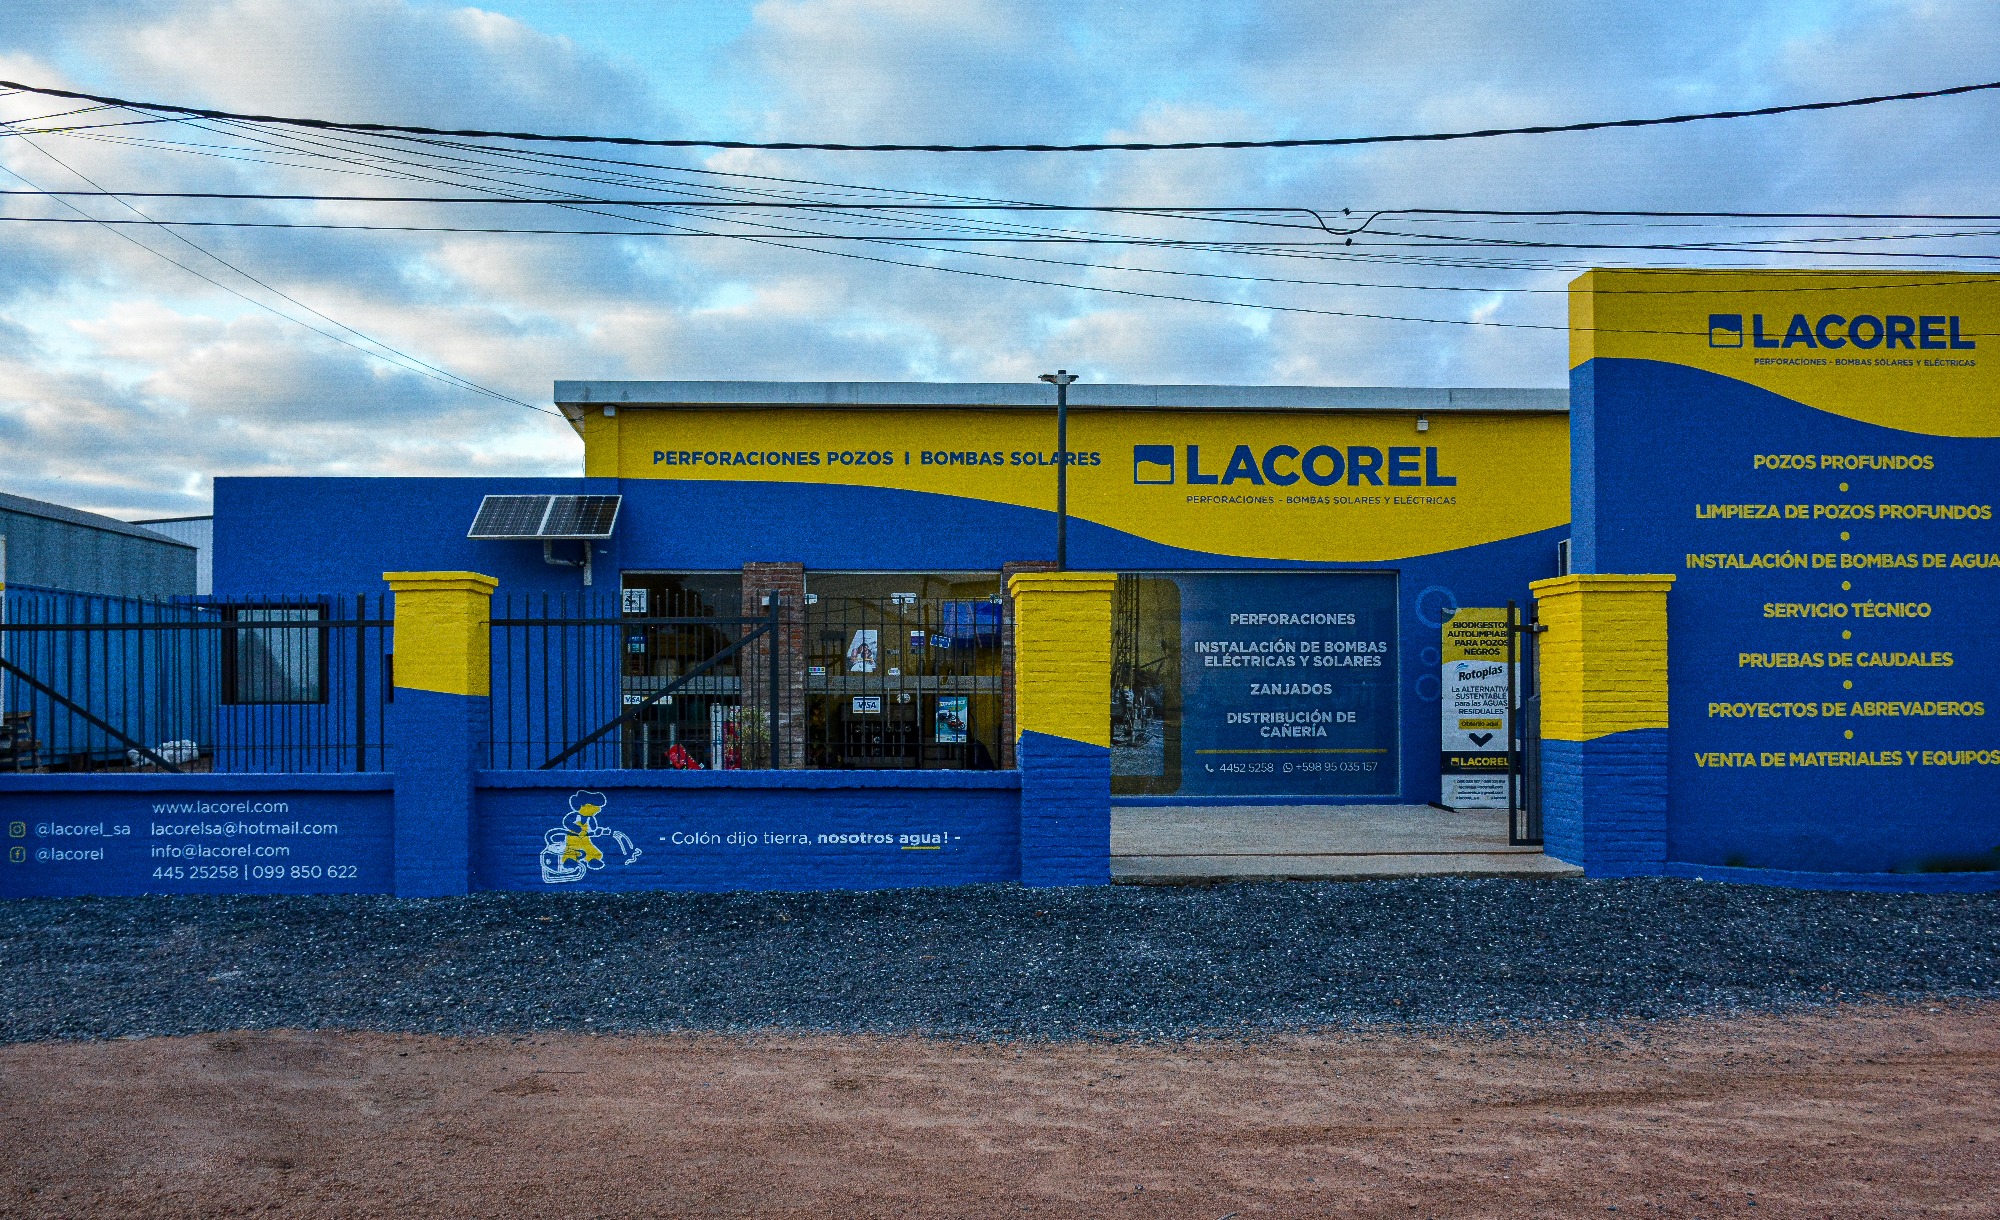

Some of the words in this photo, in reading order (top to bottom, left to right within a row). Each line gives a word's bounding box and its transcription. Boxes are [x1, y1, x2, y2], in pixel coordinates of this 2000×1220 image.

[1753, 314, 1976, 350] LACOREL
[1754, 358, 1827, 366] PERFORACIONES
[653, 451, 821, 465] PERFORACIONES
[827, 451, 893, 465] POZOS
[921, 451, 1005, 465] BOMBAS
[1754, 455, 1816, 469] POZOS
[1821, 455, 1934, 469] PROFUNDOS
[1187, 445, 1456, 486] LACOREL
[1186, 496, 1274, 504] PERFORACIONES
[1286, 496, 1330, 504] BOMBAS
[1334, 496, 1380, 504] SOLARES
[1384, 496, 1390, 504] Y
[1696, 505, 1780, 519] LIMPIEZA
[1785, 505, 1809, 519] DE
[1814, 505, 1875, 519] POZOS
[1879, 505, 1992, 520] PROFUNDOS
[1686, 550, 1808, 568] INSTALACIÓN
[1812, 554, 1836, 568] DE
[1841, 554, 1918, 568] BOMBAS
[1922, 554, 1946, 568] DE
[1950, 554, 2000, 568] AGUA
[1763, 603, 1848, 617] SERVICIO
[1852, 599, 1931, 617] TÉCNICO
[1230, 614, 1356, 625] PERFORACIONES
[1195, 639, 1296, 653] INSTALACIÓN
[1300, 642, 1320, 653] DE
[1324, 641, 1387, 653] BOMBAS
[1204, 653, 1295, 667] ELÉCTRICAS
[1300, 656, 1310, 667] Y
[1313, 656, 1382, 667] SOLARES
[1739, 653, 1824, 668] PRUEBAS
[1829, 652, 1852, 667] DE
[1857, 652, 1953, 667] CAUDALES
[1458, 666, 1503, 681] Rotoplas
[1250, 684, 1332, 695] ZANJADOS
[1708, 702, 1818, 717] PROYECTOS
[1822, 702, 1846, 716] DE
[1850, 701, 1984, 716] ABREVADEROS
[1227, 709, 1332, 724] DISTRIBUCIÓN
[1336, 712, 1356, 723] DE
[1260, 724, 1327, 738] CAÑERÍA
[1695, 752, 1756, 767] VENTA
[1761, 752, 1785, 767] DE
[1790, 752, 1902, 766] MATERIALES
[1906, 751, 1918, 765] Y
[1923, 750, 2000, 766] EQUIPOS
[1220, 764, 1246, 772] 4452
[1249, 763, 1274, 772] 5258
[1296, 763, 1322, 772] +598
[1324, 763, 1338, 772] 95
[1340, 762, 1361, 772] 035
[1363, 762, 1378, 771] 157
[152, 800, 288, 813] www.lacorel.com
[35, 822, 131, 837] @lacorel_sa
[152, 822, 338, 837] lacorelsa@hotmail.com
[672, 831, 721, 845] Colón
[727, 832, 758, 847] dijo
[764, 832, 812, 847] tierra,
[818, 832, 894, 845] nosotros
[900, 832, 948, 846] agua!
[35, 848, 103, 862] @lacorel
[152, 843, 290, 859] info@lacorel.com
[152, 866, 184, 879] 445
[190, 866, 239, 879] 25258
[252, 866, 285, 879] 099
[291, 866, 322, 878] 850
[327, 866, 357, 878] 622
